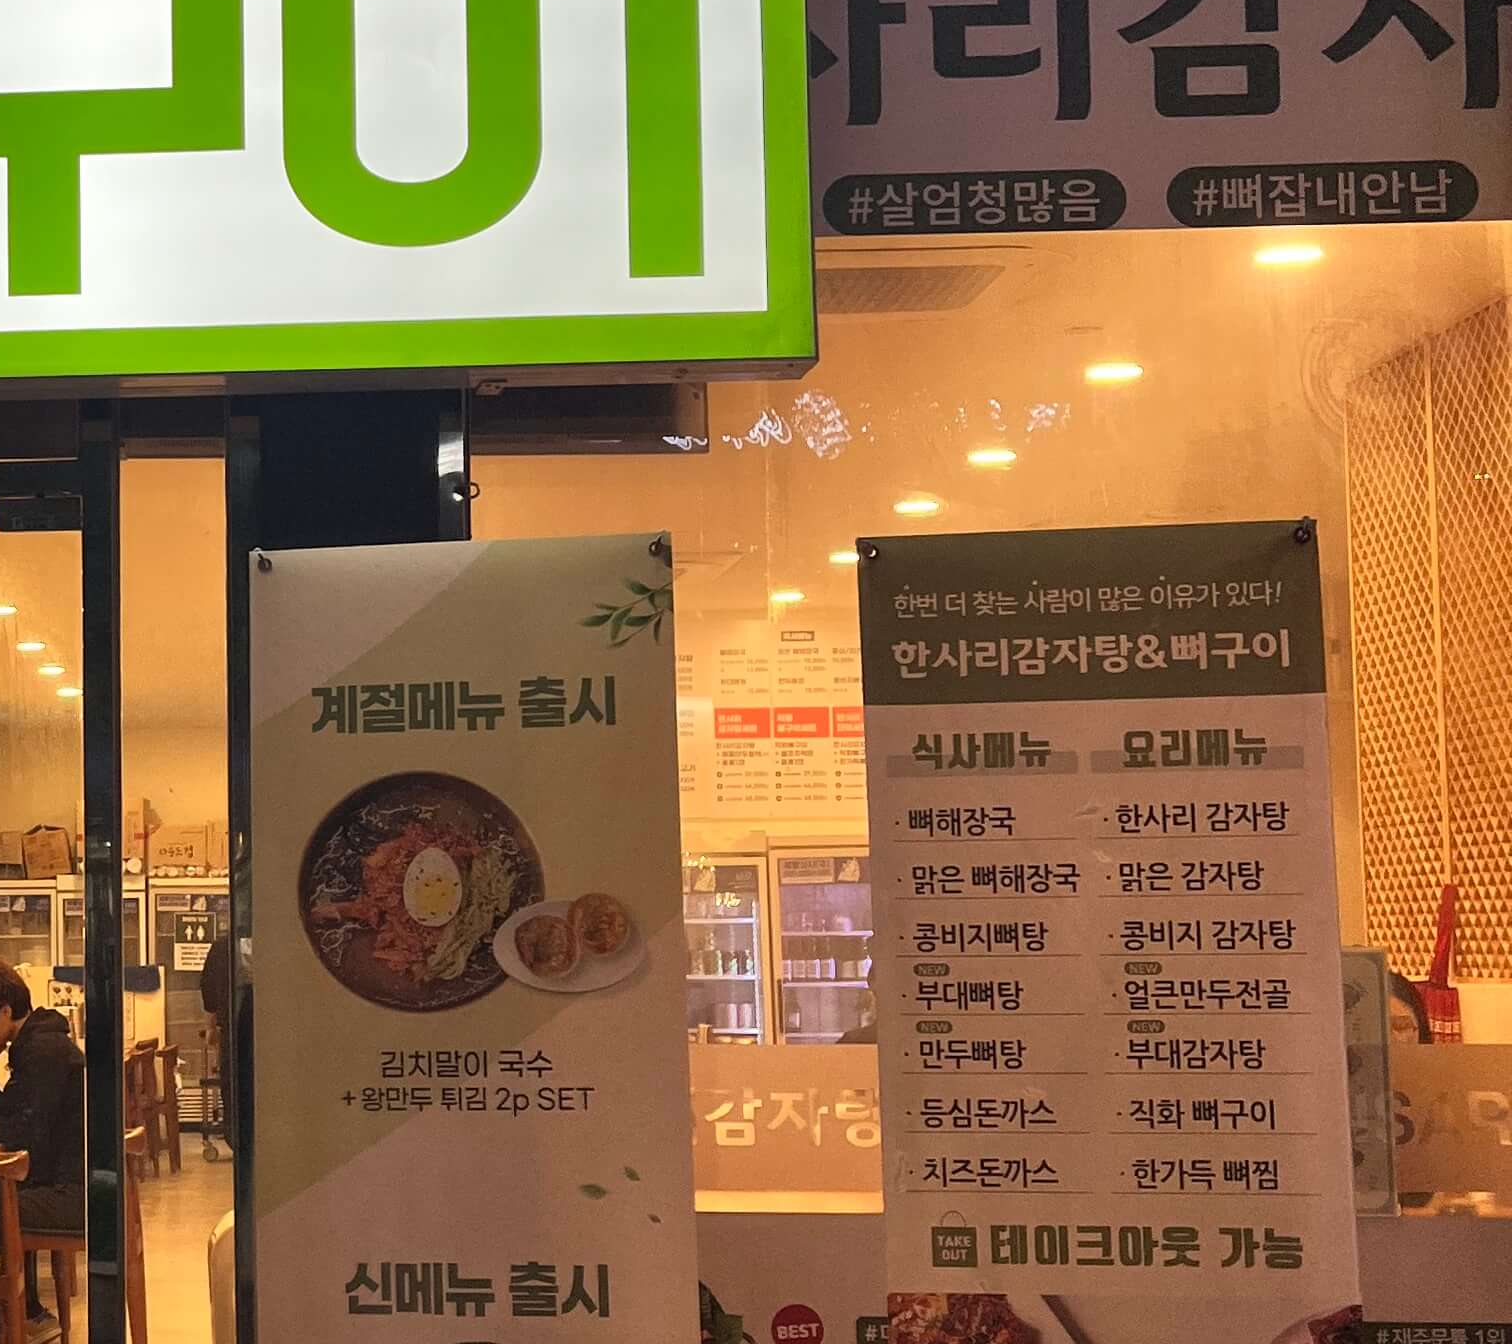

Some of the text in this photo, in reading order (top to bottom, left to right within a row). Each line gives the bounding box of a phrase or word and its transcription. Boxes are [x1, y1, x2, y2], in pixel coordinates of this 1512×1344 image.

[848, 181, 1101, 227] #살엄청많음
[1192, 168, 1453, 218] #뼈잡내안남
[893, 578, 1282, 618] 한번 더 찾는 사람이 많은 이유가 있다!
[892, 629, 1290, 678] 한사리감자탕&뼈구이
[311, 676, 617, 734] 계절메뉴 출시
[912, 730, 1051, 770] 식사메뉴
[1123, 728, 1267, 768] 요리메뉴
[908, 807, 1016, 838] 뼈해장국
[1115, 801, 1290, 834] 한사리 감자탕
[912, 862, 1081, 895] 맑은 뼈해장국
[1119, 860, 1264, 892] 맑은 감자탕
[913, 921, 1049, 953] 콩비지뼈탕
[1119, 919, 1297, 951] 콩비지 감자탕
[917, 965, 948, 976] NEW
[1128, 963, 1159, 974] NEW
[915, 980, 1024, 1011] 부대뼈탕
[1124, 979, 1291, 1010] 얼큰만두전골
[920, 1022, 951, 1033] NEW
[1131, 1021, 1162, 1033] NEW
[380, 1051, 553, 1078] 김치말이 국수
[919, 1039, 1027, 1070] 만두뼈탕
[1126, 1039, 1266, 1070] 부대감자탕
[439, 1086, 488, 1113] 튀김
[495, 1087, 530, 1117] 2p
[536, 1086, 595, 1112] SET
[920, 1098, 1057, 1129] 등심돈까스
[1129, 1099, 1276, 1130] 직화 뼈구이
[922, 1158, 1059, 1189] 치즈돈까스
[1132, 1159, 1279, 1190] 한가득 뼈찜
[937, 1235, 972, 1248] TAKE
[941, 1248, 970, 1262] OUT
[990, 1224, 1303, 1269] 테이크아웃 가능
[345, 1262, 609, 1318] 신메뉴 출시
[776, 1323, 820, 1340] BEST
